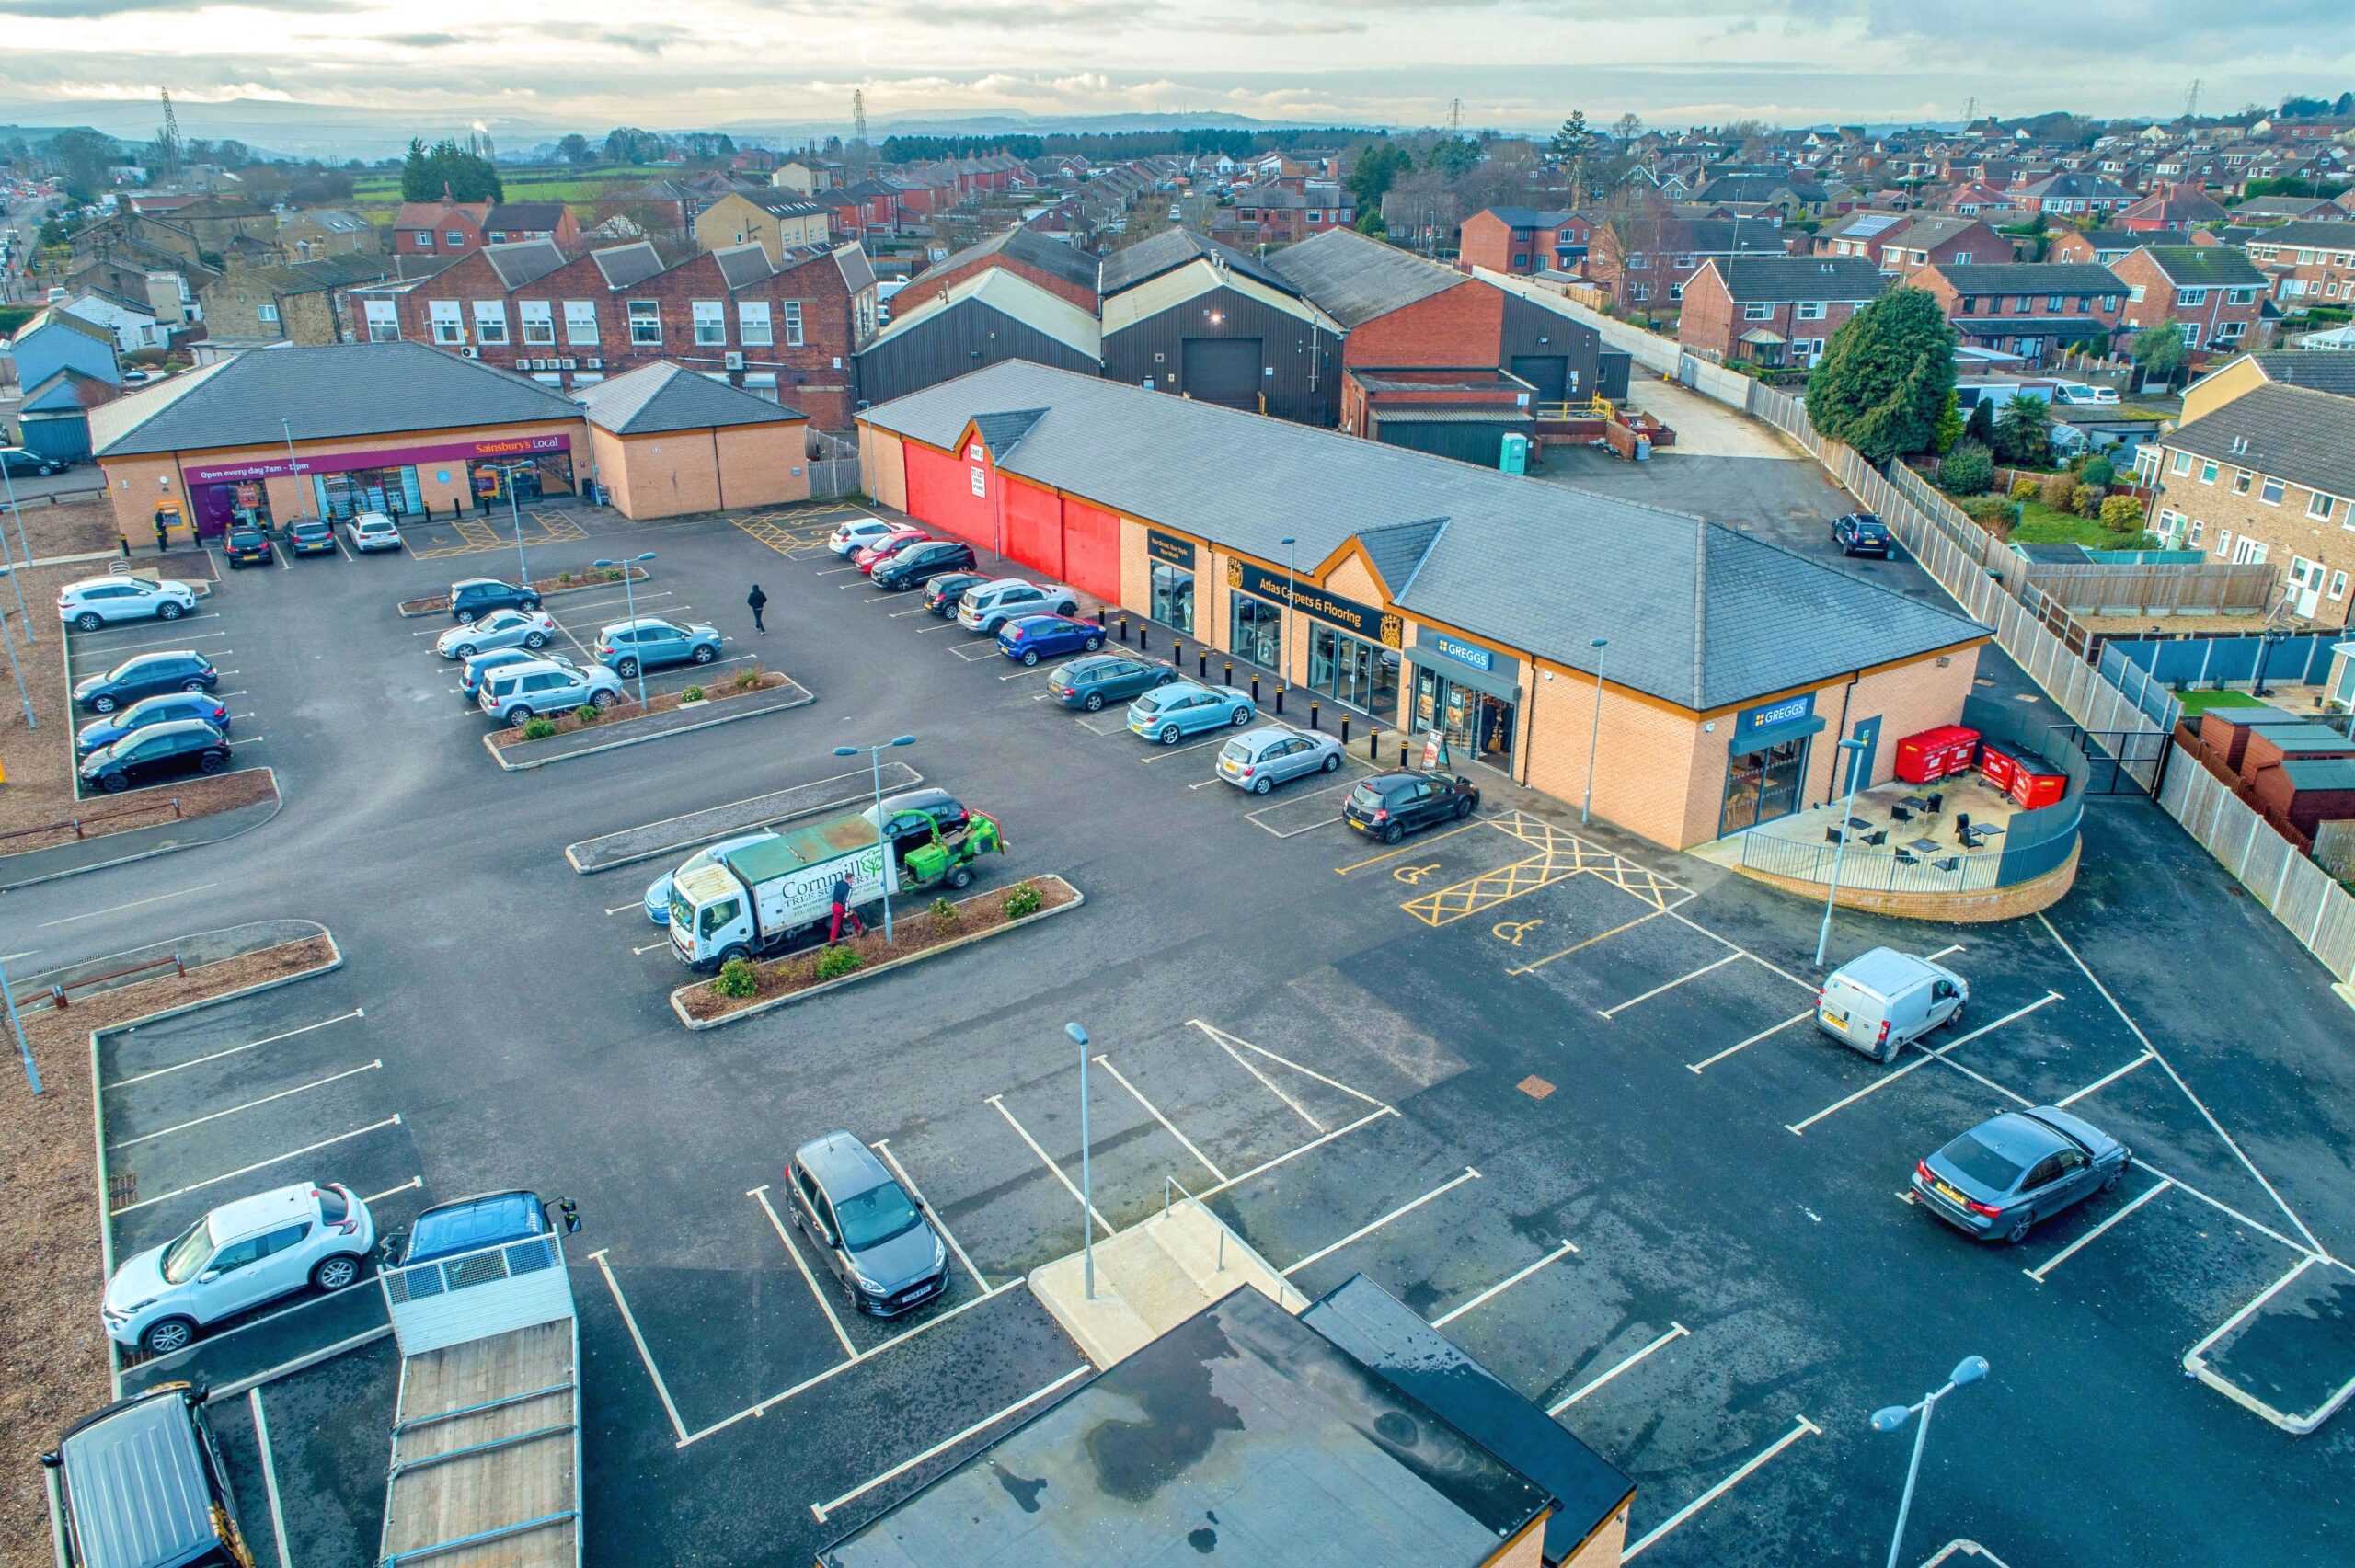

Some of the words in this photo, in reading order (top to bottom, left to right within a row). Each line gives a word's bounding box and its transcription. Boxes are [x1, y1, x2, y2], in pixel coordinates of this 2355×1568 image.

[475, 441, 531, 453] Sainsbury's
[532, 437, 558, 449] Local
[200, 471, 223, 479] Open
[224, 468, 247, 476] every
[247, 466, 264, 475] day
[1259, 578, 1281, 595] Atlas
[1281, 587, 1314, 607] Carpets
[1315, 598, 1322, 611] &
[1324, 601, 1361, 628] Flooring
[1448, 644, 1487, 666] GREGGS
[1764, 703, 1805, 723] GREGGS
[782, 860, 860, 899] Cornmill
[784, 890, 816, 907] TREE
